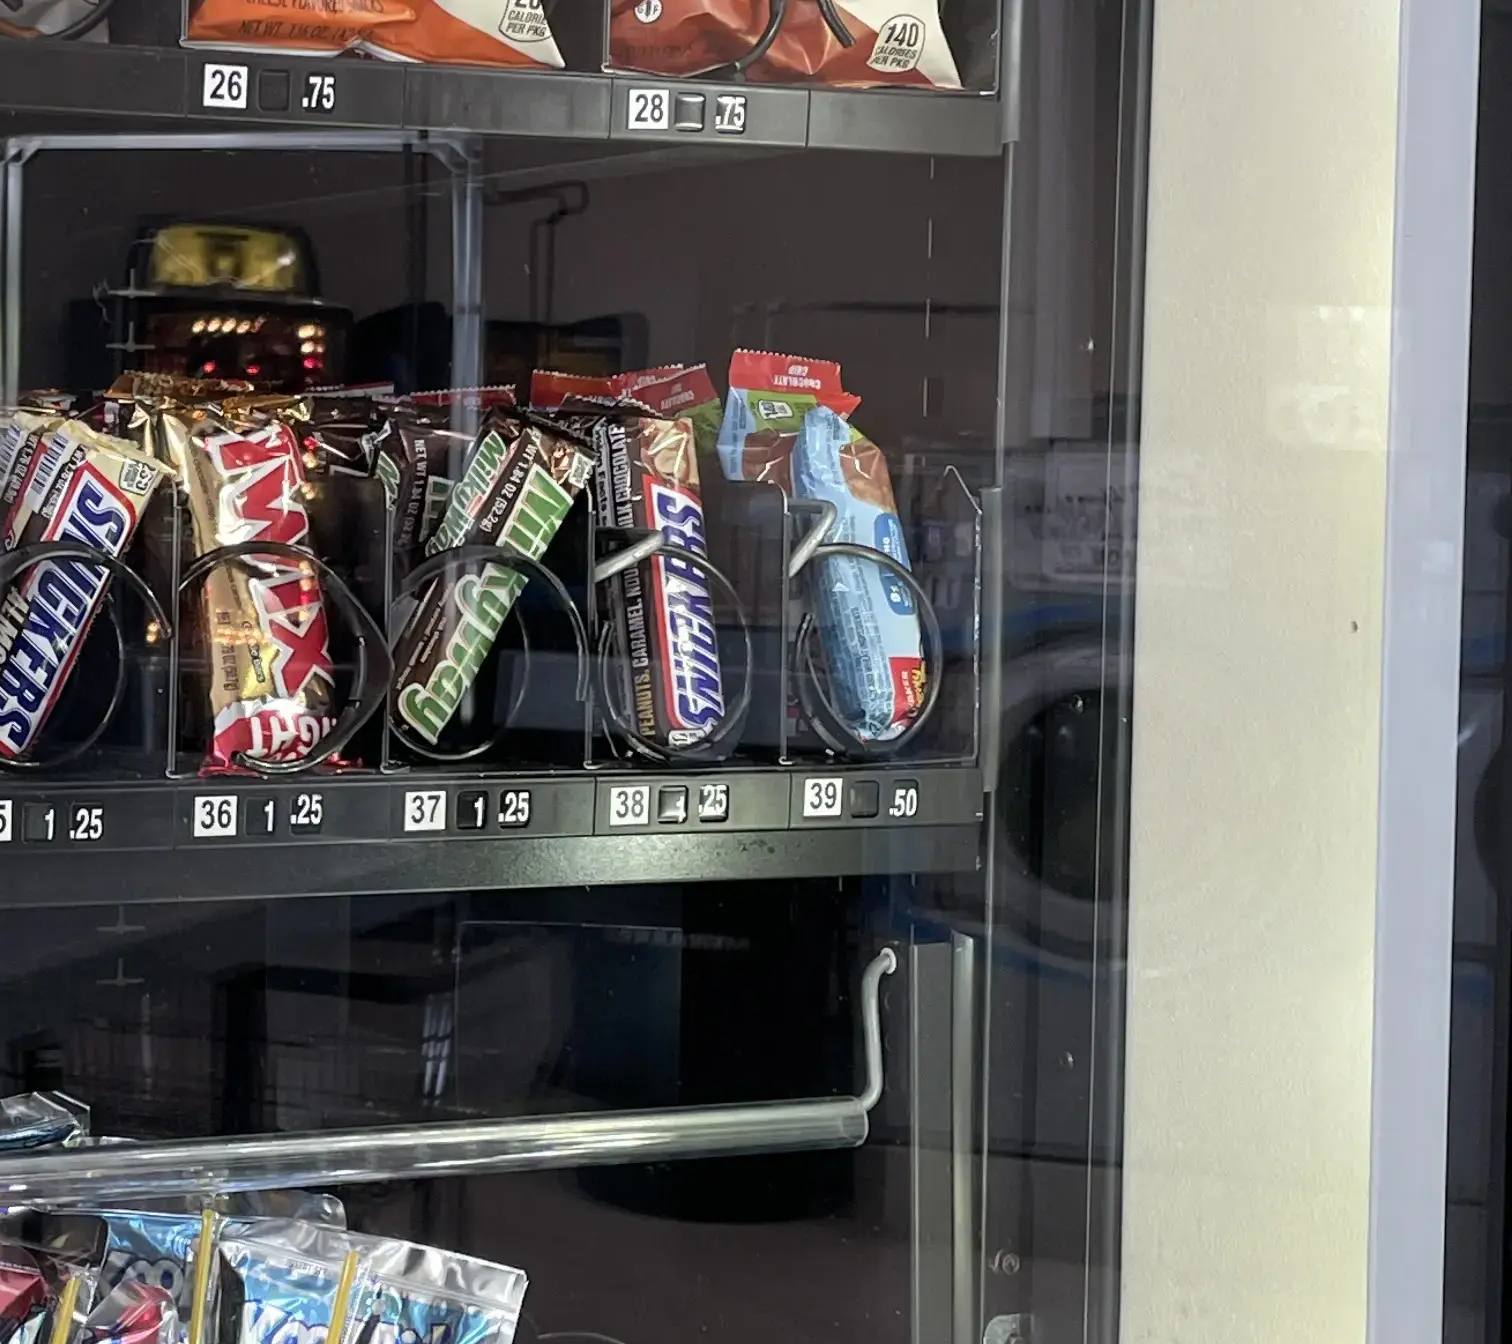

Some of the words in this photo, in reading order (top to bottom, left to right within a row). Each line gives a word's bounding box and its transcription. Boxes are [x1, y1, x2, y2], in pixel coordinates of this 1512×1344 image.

[887, 23, 919, 48] 140
[209, 70, 242, 100] 26
[302, 77, 335, 108] .75
[635, 96, 663, 122] 28
[654, 493, 726, 730] SNICKERS
[615, 791, 644, 818] 38
[809, 784, 837, 808] 39
[889, 789, 918, 816] .50
[200, 802, 231, 829] 36
[411, 797, 439, 823] 37
